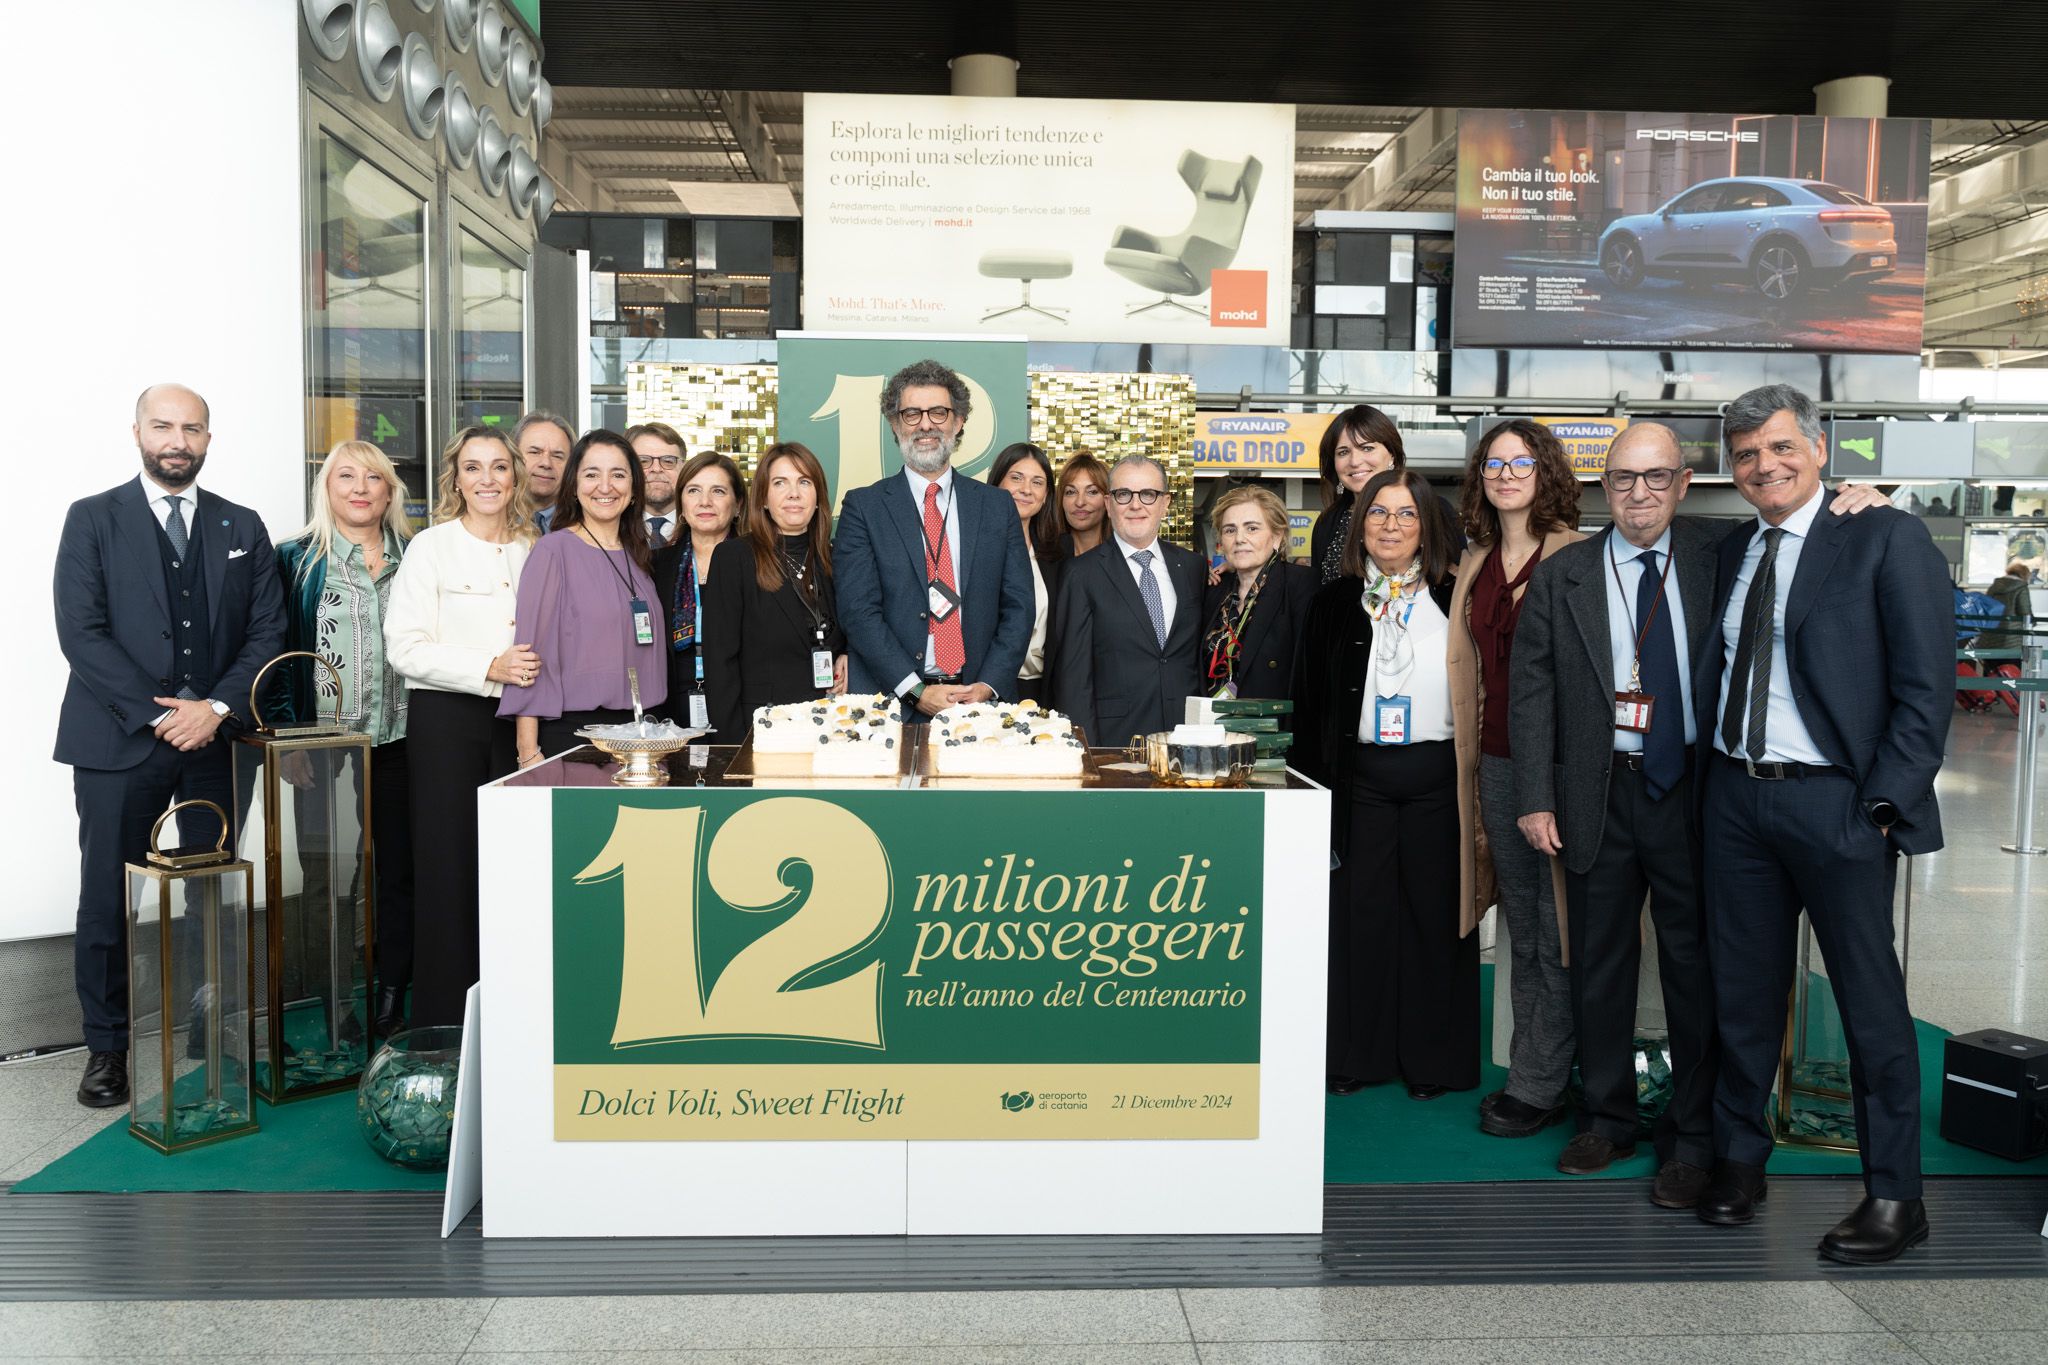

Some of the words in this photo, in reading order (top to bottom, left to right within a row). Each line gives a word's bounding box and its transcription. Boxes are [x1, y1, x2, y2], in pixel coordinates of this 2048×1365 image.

[832, 121, 902, 142] Esplora
[908, 122, 923, 140] le
[928, 123, 999, 145] migliori
[1006, 125, 1088, 143] tendenze
[1093, 131, 1103, 143] e
[1636, 129, 1759, 142] PORSCHE
[830, 147, 910, 167] componi
[916, 151, 950, 165] una
[954, 148, 1039, 167] selezione
[1044, 151, 1093, 167] unica
[830, 174, 841, 185] e
[845, 170, 931, 191] originale.
[1482, 167, 1532, 182] Cambia
[1534, 168, 1542, 182] il
[1545, 170, 1567, 183] tuo
[1569, 169, 1600, 184] look.
[1482, 186, 1508, 200] Non
[1511, 187, 1519, 200] il
[1522, 188, 1543, 201] tuo
[1546, 188, 1577, 202] stile.
[899, 203, 964, 213] Illuminazione
[976, 204, 1009, 216] Design
[1012, 205, 1049, 215] Service
[1051, 205, 1066, 215] dal
[1068, 206, 1091, 216] 1968
[830, 215, 883, 226] Worldwide
[886, 216, 926, 228] Delivery
[934, 217, 974, 227] mohd.it
[911, 298, 947, 311] More.
[1220, 310, 1258, 320] mohd
[1221, 421, 1287, 432] RYANAIR
[1556, 426, 1614, 436] RYANAIR
[1193, 440, 1237, 462] BAG
[1243, 441, 1305, 463] DROP
[1577, 444, 1608, 455] DROP
[1574, 457, 1605, 468] CHEC
[1291, 536, 1306, 547] OP
[913, 853, 1133, 913] milioni
[1149, 854, 1211, 913] di
[572, 796, 893, 1050] 12
[902, 906, 1249, 978] passeggeri
[1043, 981, 1087, 1007] del
[1094, 981, 1247, 1007] Centenario
[1039, 1093, 1088, 1103] aeroporto
[1112, 1095, 1125, 1109] 21
[1130, 1095, 1198, 1109] Dicembre
[1200, 1095, 1233, 1109] 2024
[577, 1089, 657, 1116] Dolci
[667, 1089, 722, 1120] Voli,
[731, 1089, 815, 1116] Sweet
[819, 1088, 905, 1122] Flight
[1039, 1101, 1048, 1110] di
[1050, 1102, 1088, 1110] catania
